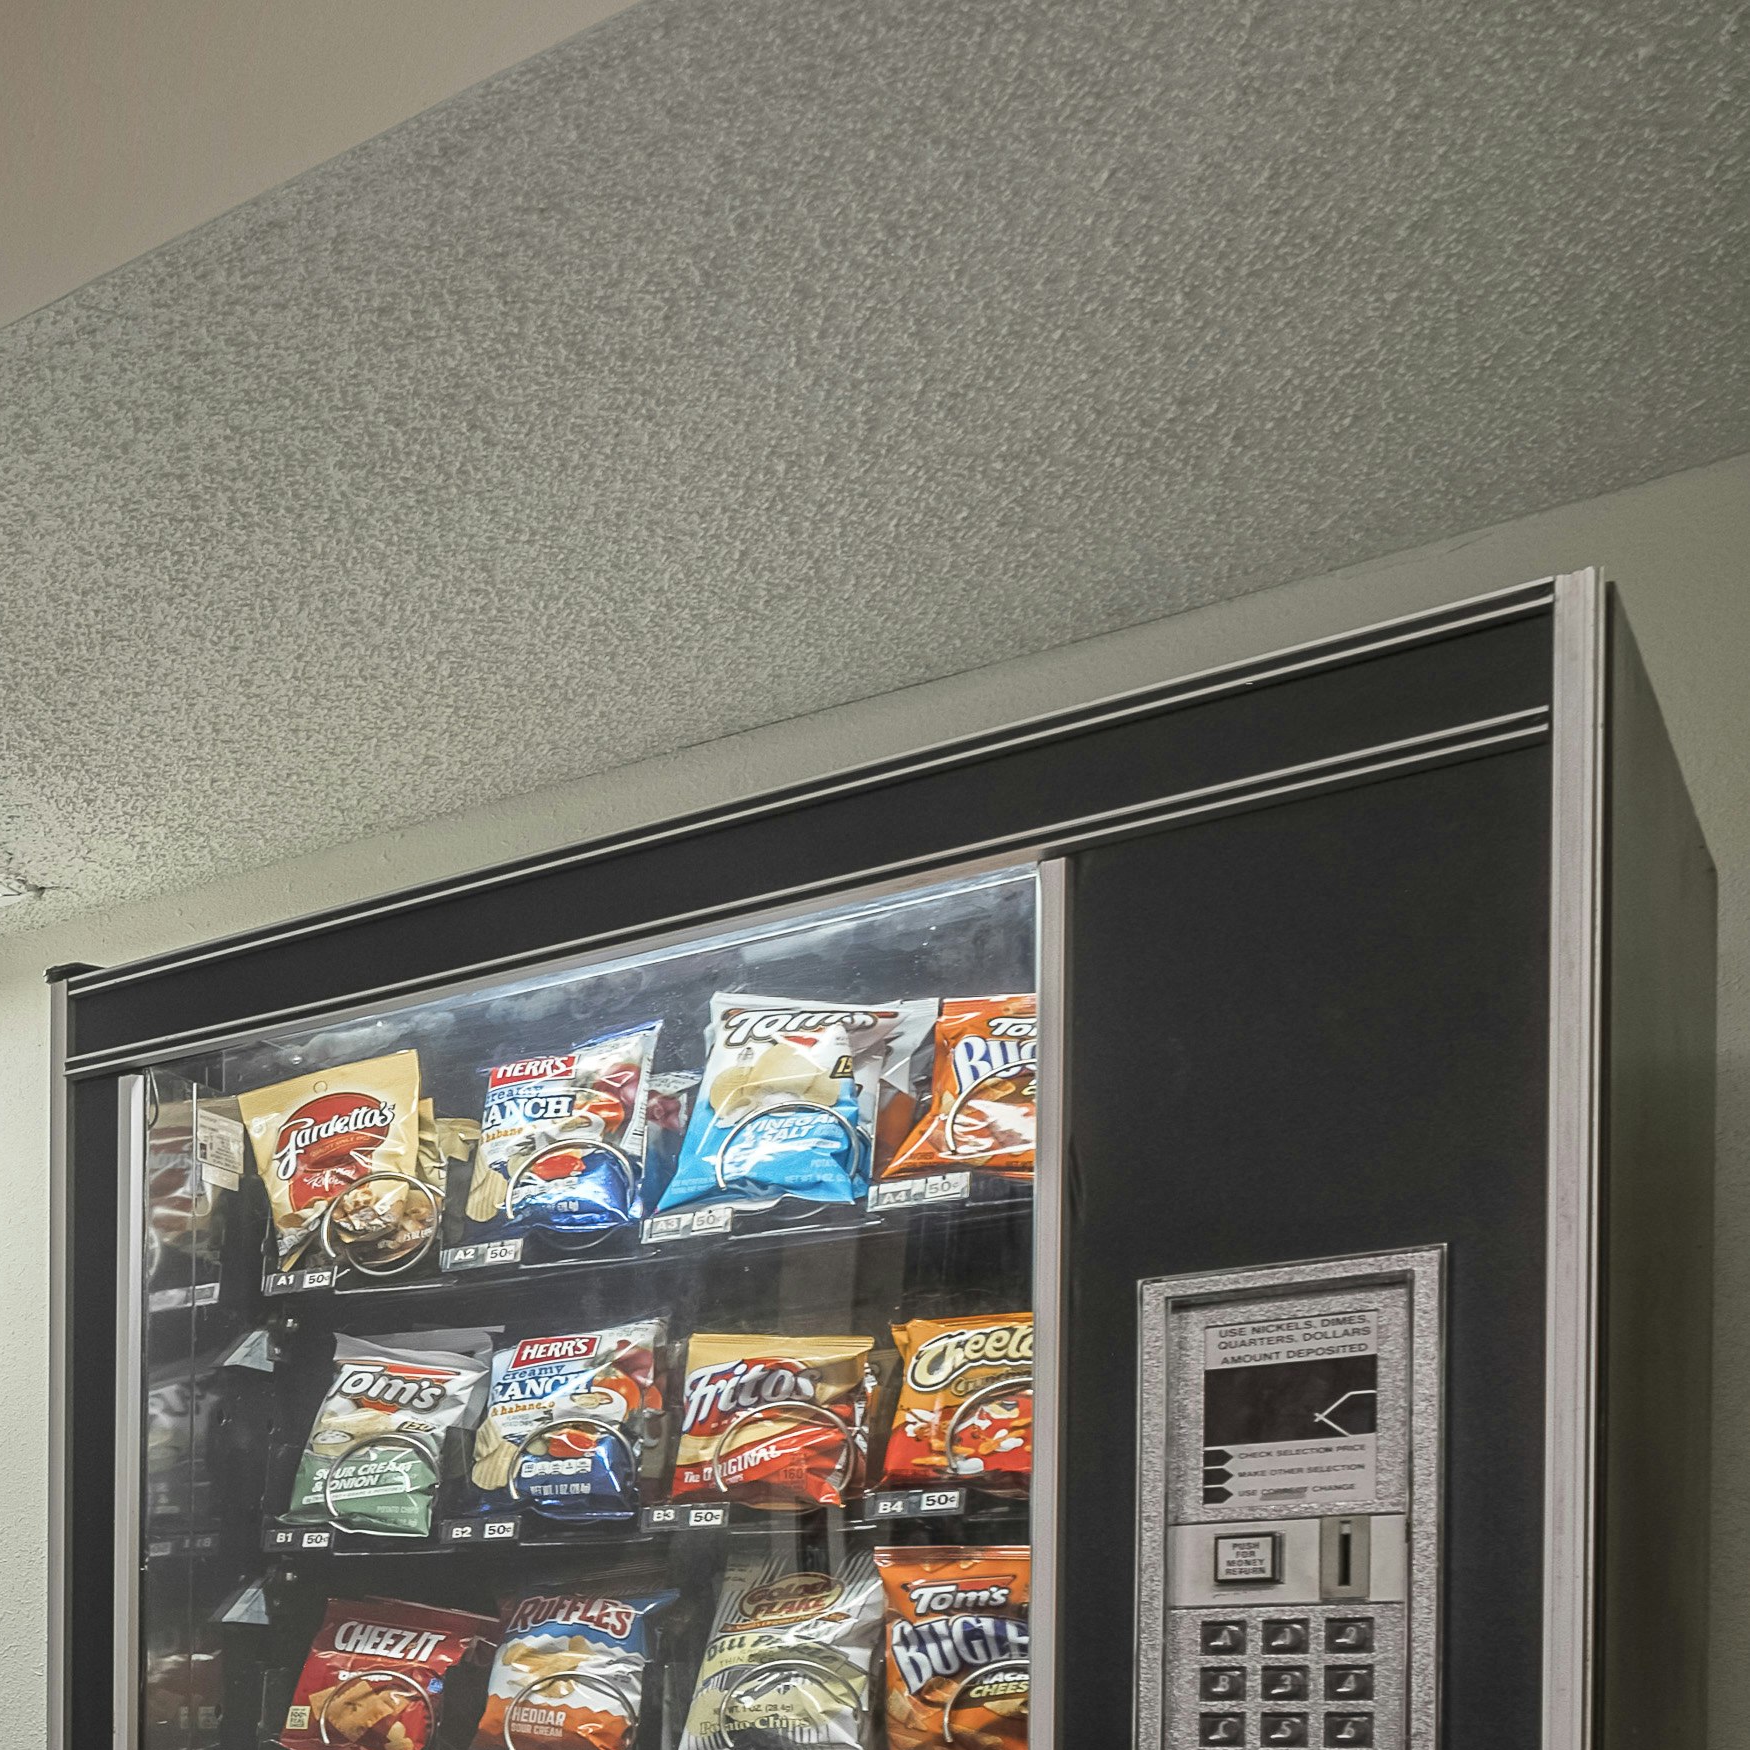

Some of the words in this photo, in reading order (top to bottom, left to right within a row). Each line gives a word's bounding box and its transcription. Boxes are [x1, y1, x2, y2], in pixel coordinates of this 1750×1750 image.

[497, 1056, 571, 1079] HERR'S
[484, 1096, 574, 1130] ANCH
[273, 1101, 396, 1180] Gardetto's
[883, 1191, 907, 1204] A4
[656, 1220, 677, 1231] A3
[454, 1248, 475, 1260] A2
[277, 1275, 295, 1286] A1
[1219, 1328, 1246, 1338] USE
[1302, 1326, 1371, 1342] DOLLARS
[521, 1338, 590, 1360] HERR'S
[1221, 1351, 1281, 1366] AMOUNT
[1286, 1343, 1369, 1359] DEPOSITED
[327, 1364, 443, 1409] Tom's
[682, 1359, 822, 1432] Fritos
[1238, 1451, 1273, 1460] CHECK
[1276, 1446, 1333, 1457] SELECTION
[1336, 1444, 1366, 1452] PRICE
[1238, 1470, 1267, 1478] MAKE
[1269, 1467, 1304, 1476] OTHER
[1306, 1464, 1366, 1473] SELECTION
[1238, 1489, 1258, 1497] USE
[1312, 1483, 1357, 1493] CHANGE
[878, 1501, 903, 1514] B4
[653, 1510, 675, 1521] B3
[276, 1533, 293, 1543] B1
[452, 1527, 472, 1538] B2
[1232, 1542, 1260, 1550] PUSH
[1226, 1559, 1266, 1567] MONEY
[1225, 1567, 1267, 1576] RETURN
[753, 1598, 825, 1618] FLAKE
[910, 1586, 1011, 1616] Tom's
[508, 1597, 635, 1638] RUFFLES
[969, 1681, 1029, 1698] CHEES
